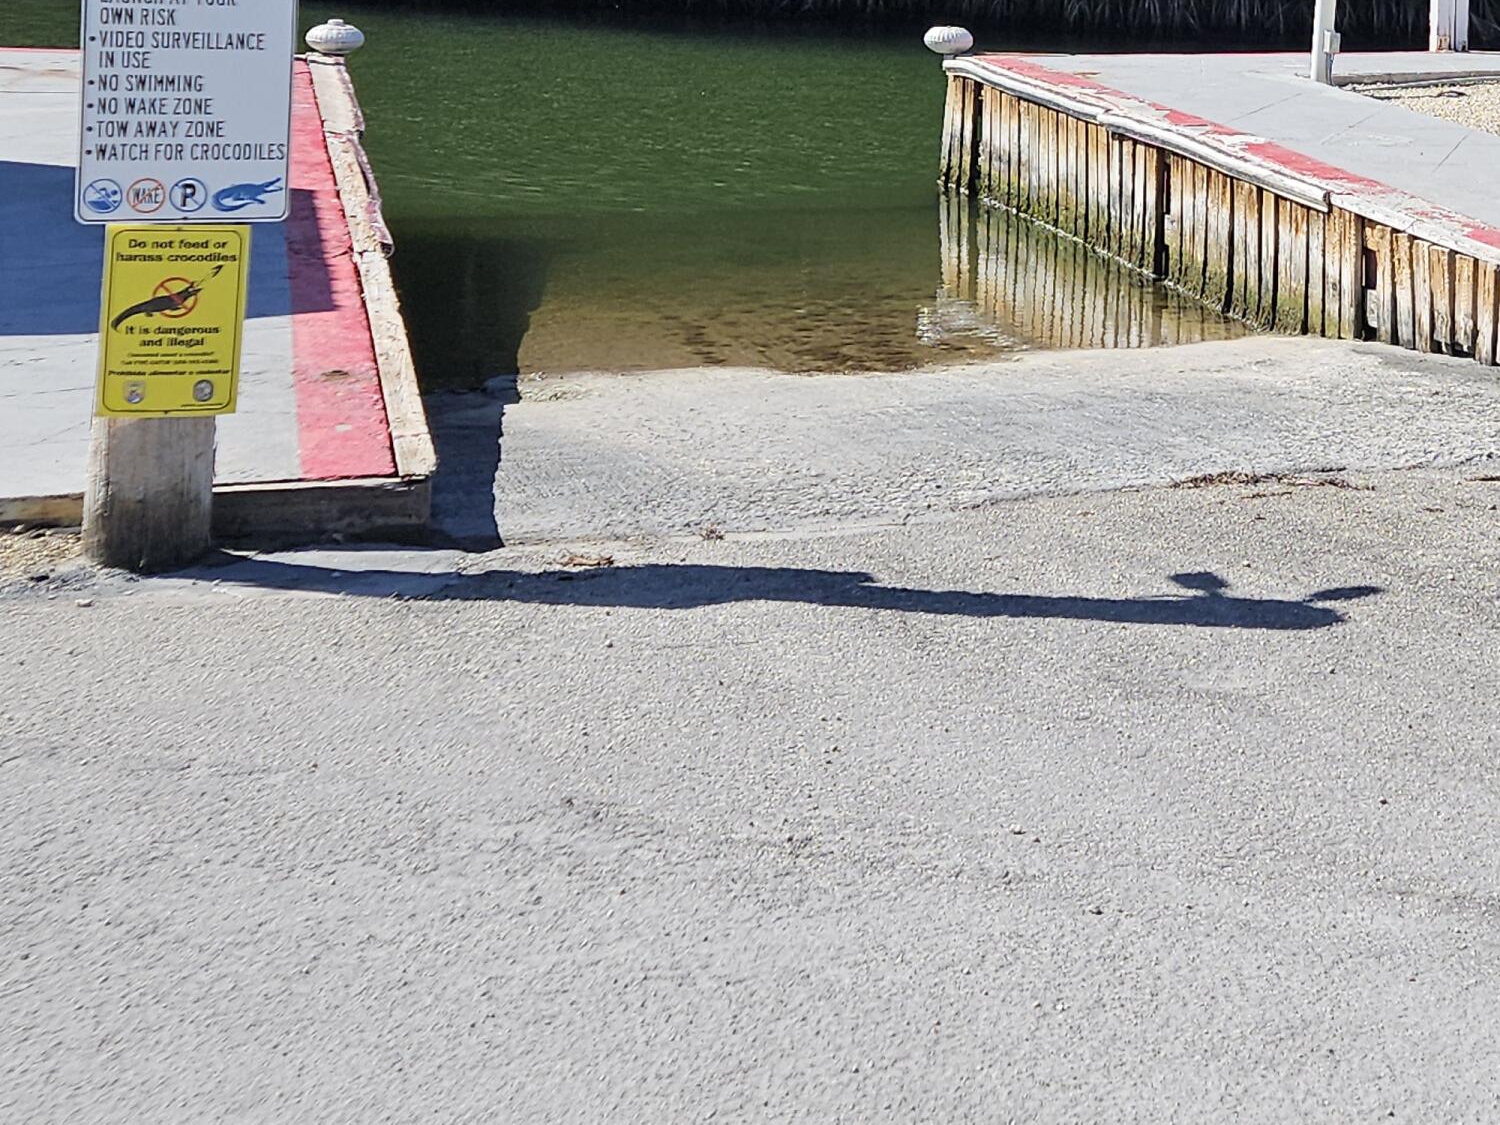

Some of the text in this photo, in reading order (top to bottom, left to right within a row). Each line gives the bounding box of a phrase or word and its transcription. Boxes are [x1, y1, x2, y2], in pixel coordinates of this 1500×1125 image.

[100, 7, 176, 26] OWN RISK
[99, 31, 265, 50] VIDEO SURVEILLANCE
[100, 51, 151, 69] IN USE
[98, 74, 204, 92] NO SWIMMING
[97, 98, 213, 115] NO WAKE ZONE
[96, 121, 226, 138] TOW AWAY ZONE
[95, 143, 285, 161] WATCH FOR CROCODILES
[132, 188, 161, 204] WAKE
[180, 183, 196, 207] P
[128, 239, 146, 248] Do
[151, 239, 175, 249] not
[178, 239, 209, 249] feed
[116, 252, 237, 262] harass crocodiles
[125, 326, 219, 335] It is dangerous
[139, 338, 204, 347] and illegal
